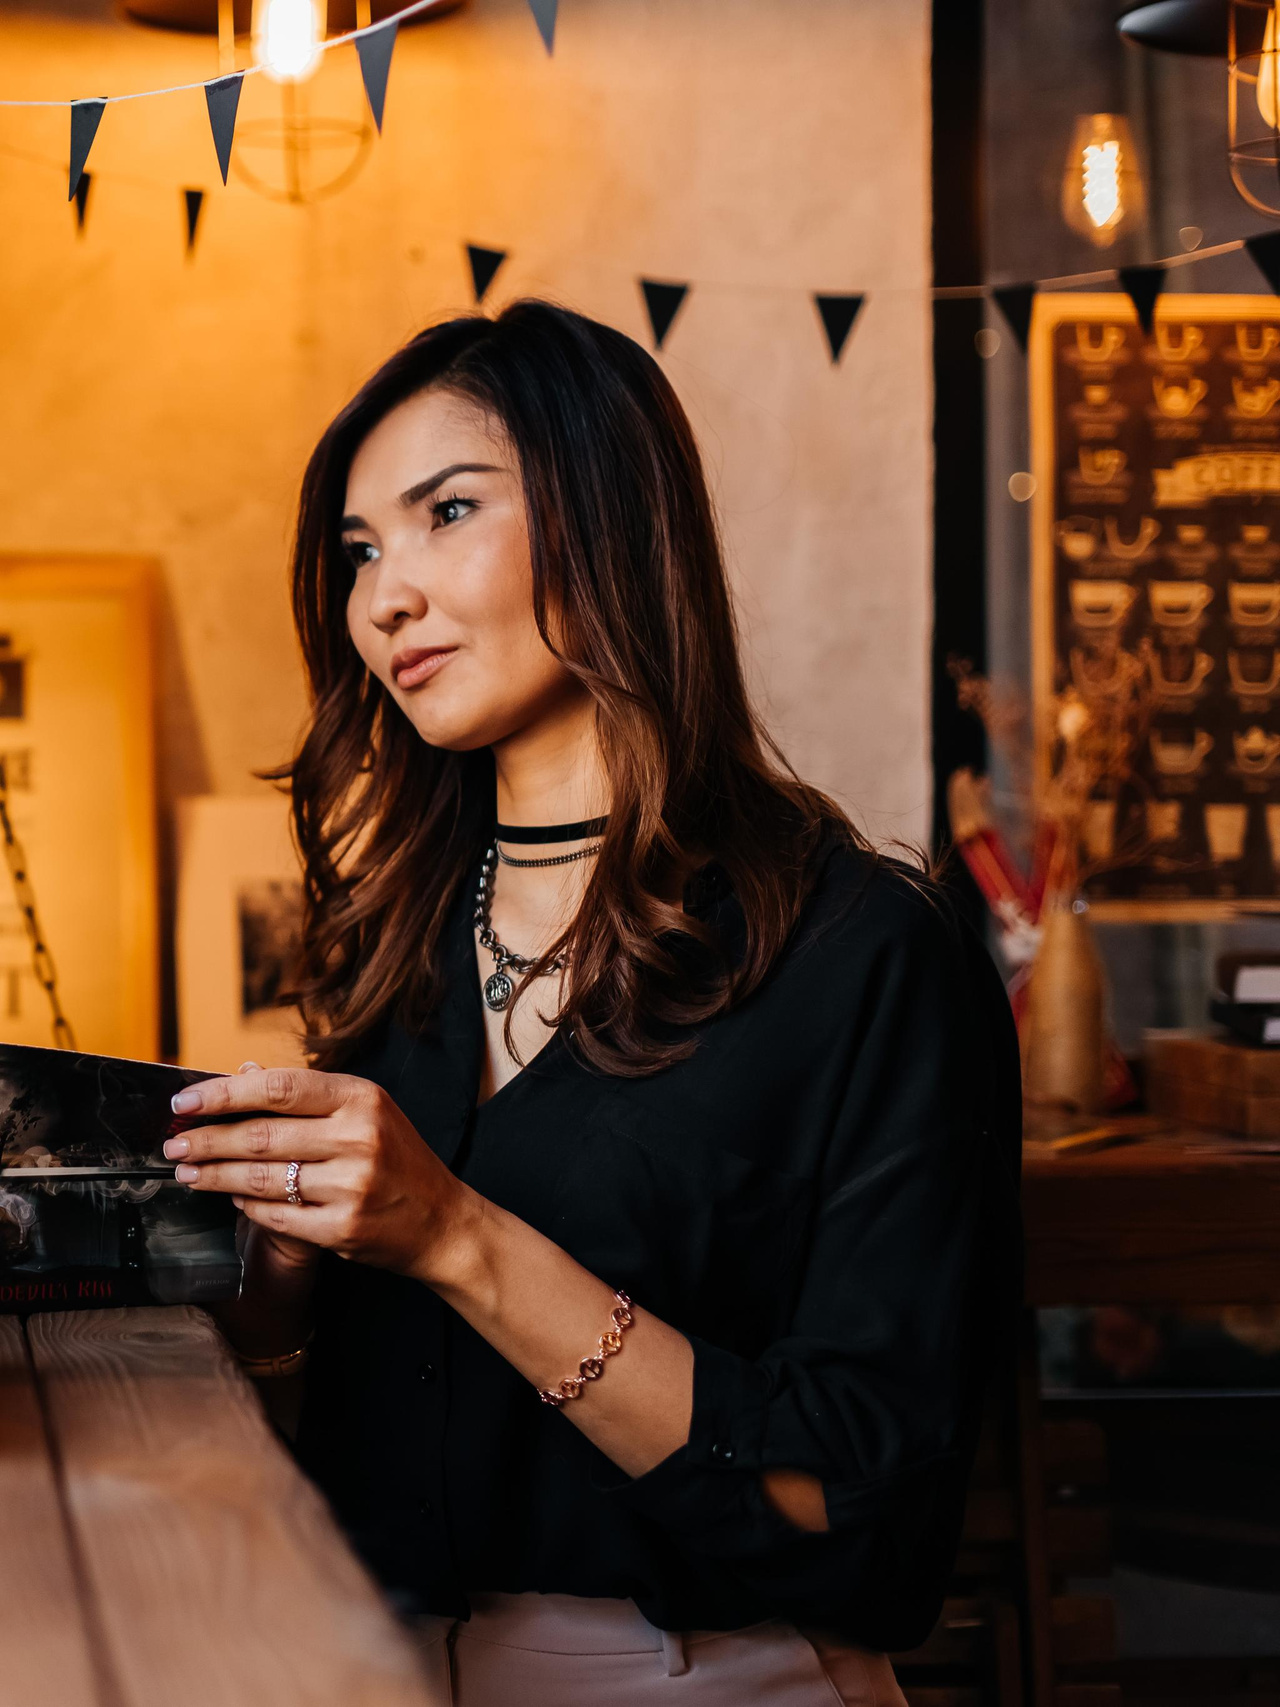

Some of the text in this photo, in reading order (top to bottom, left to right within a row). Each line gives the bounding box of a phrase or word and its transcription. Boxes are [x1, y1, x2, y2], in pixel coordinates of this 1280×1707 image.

[1194, 456, 1278, 485] COFF
[0, 1280, 112, 1302] DEVIL'S KISS
